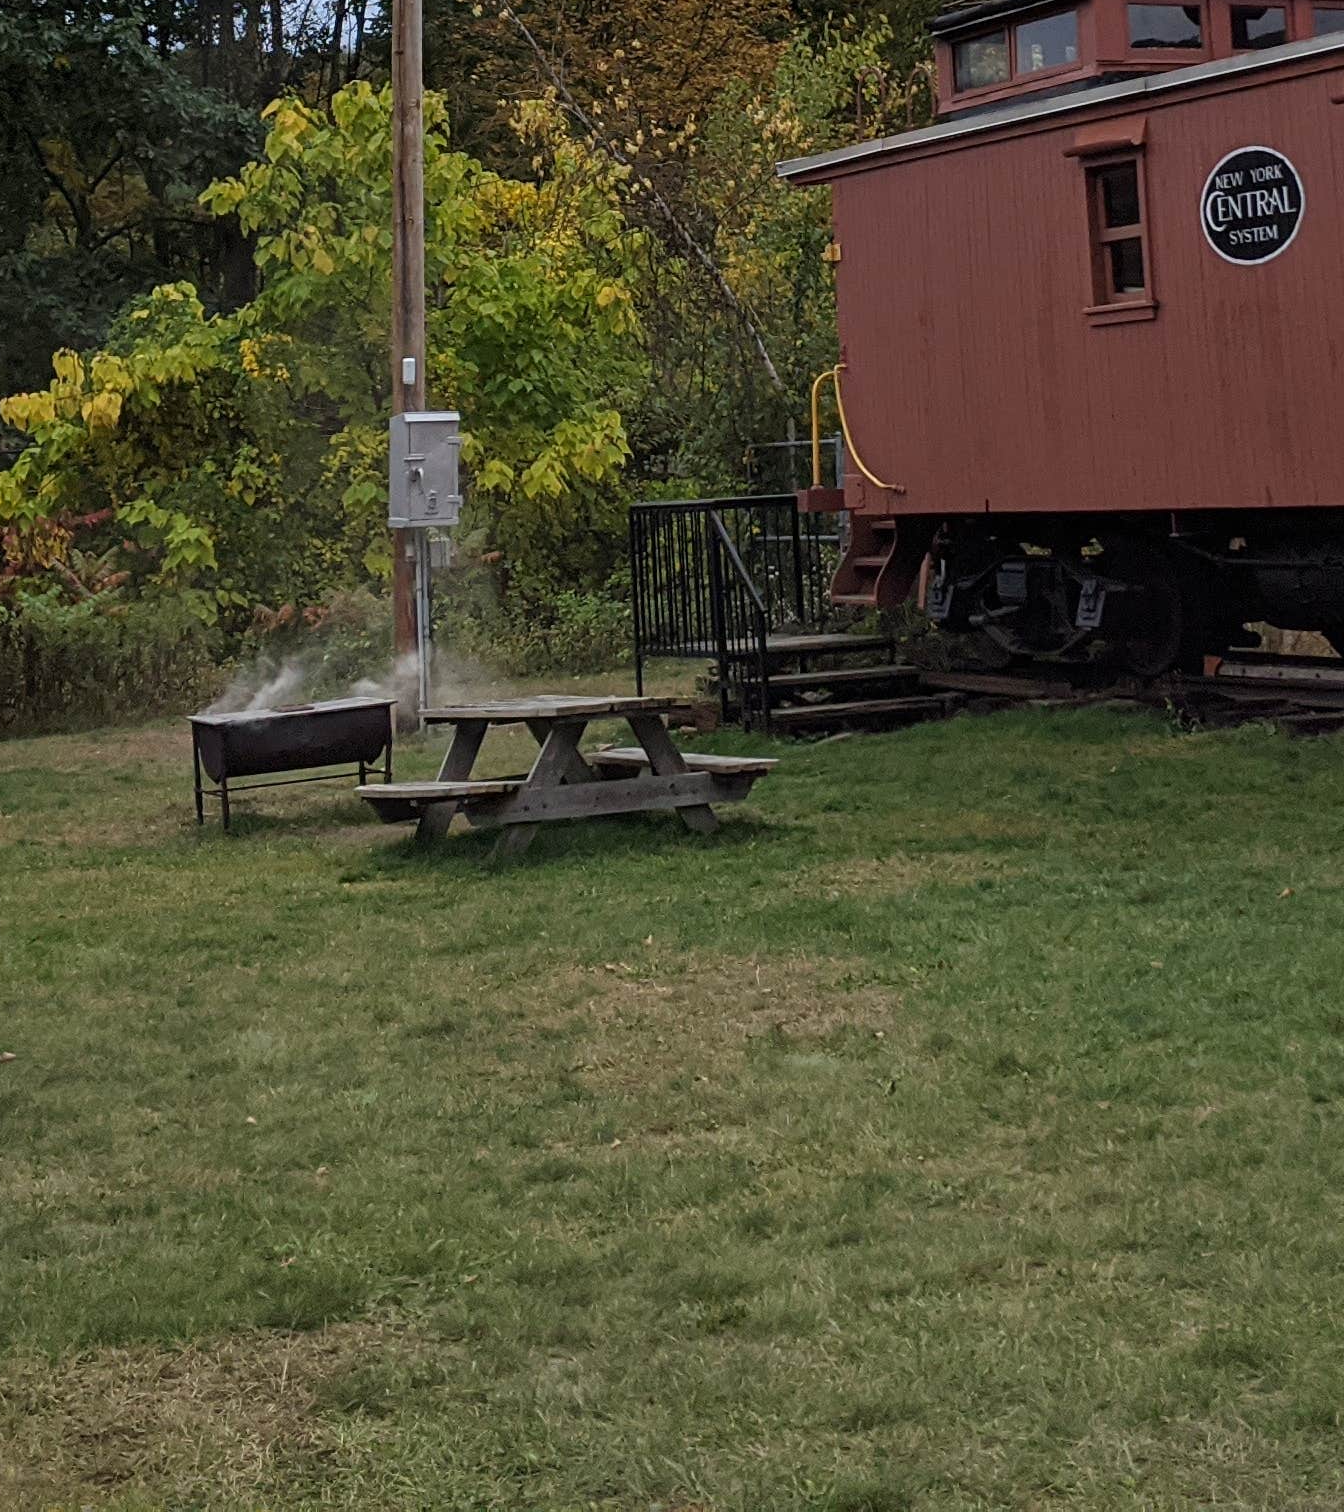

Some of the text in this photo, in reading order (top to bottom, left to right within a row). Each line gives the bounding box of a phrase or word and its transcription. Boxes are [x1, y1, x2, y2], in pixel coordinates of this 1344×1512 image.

[1215, 164, 1283, 190] NEW YORK
[1206, 185, 1296, 232] CENTRAL
[1229, 225, 1279, 245] SYSTEM
